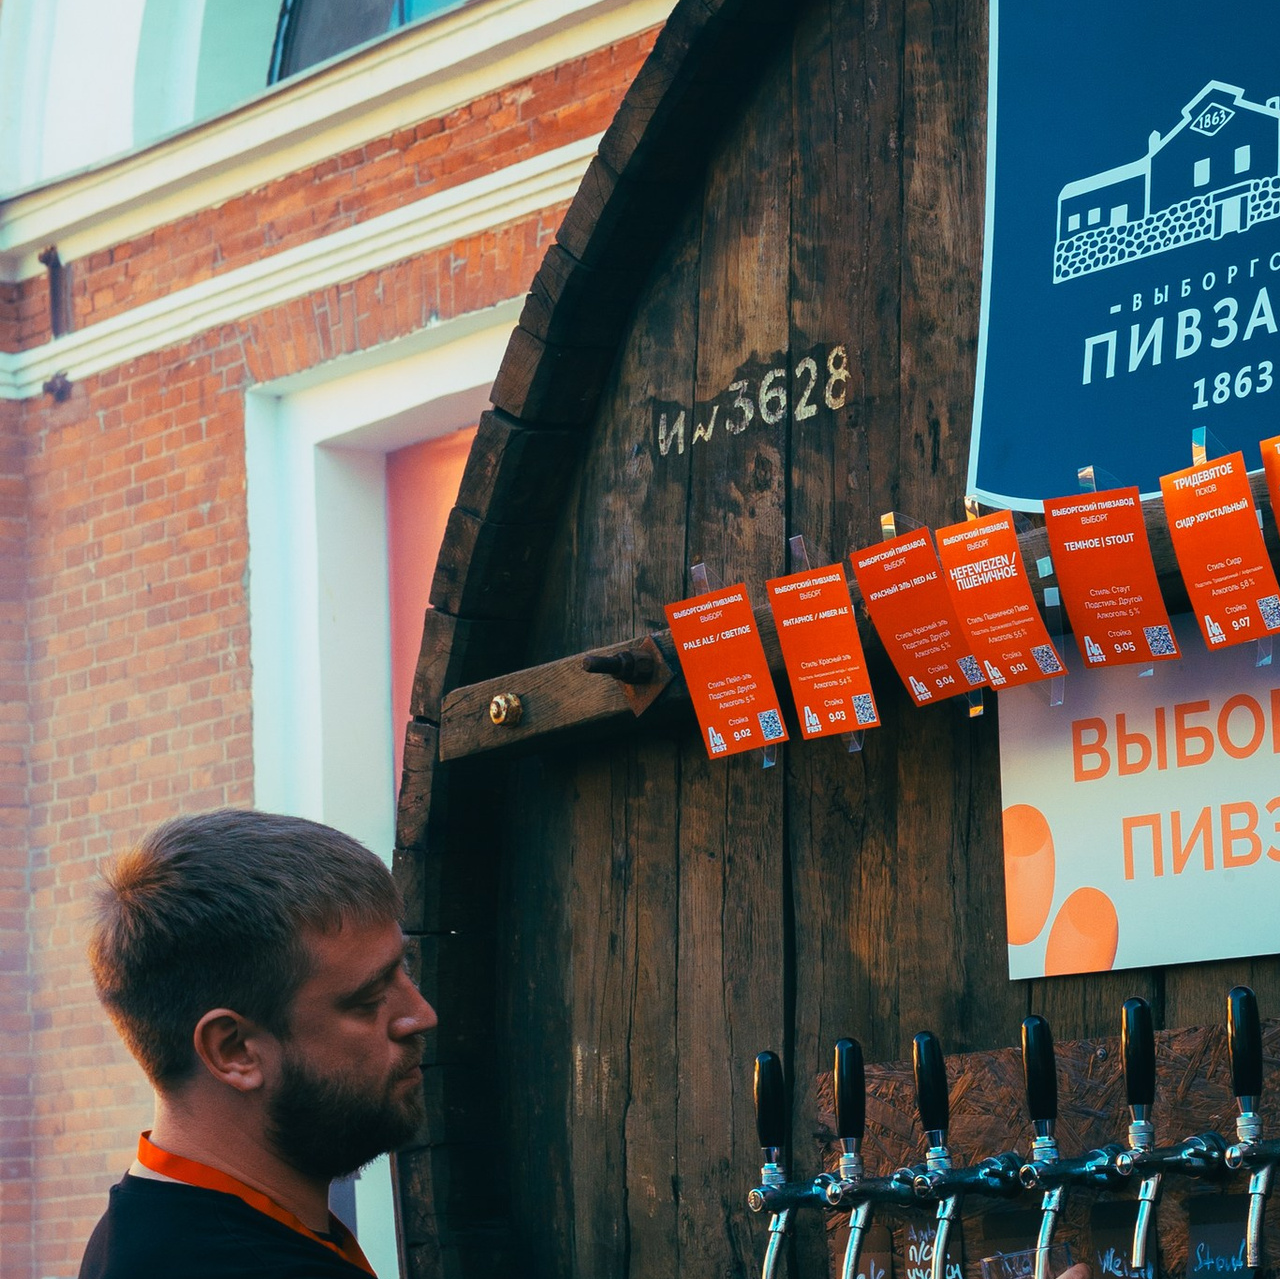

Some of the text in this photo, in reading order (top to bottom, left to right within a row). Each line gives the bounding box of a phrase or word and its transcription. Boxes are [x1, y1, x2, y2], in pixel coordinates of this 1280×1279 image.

[1199, 109, 1227, 129] 1863
[1191, 360, 1274, 411] 1863
[1173, 462, 1234, 490] ТРИДЕВЯТОЕ
[1195, 483, 1217, 497] ПСКОВ
[1051, 497, 1135, 517] ВЫБОРГСКИЙ ПИВЗАВОД
[1175, 497, 1249, 529] СИДР ХРУСТАЛЬНЫЙ
[1081, 513, 1109, 525] ВЫБОРГ
[942, 520, 1010, 546] ВЫБОРГСКИЙ ПИВЗАВОД
[966, 538, 989, 552] ВЫБОРГ
[1063, 538, 1100, 552] ТЕМНОЕ
[1105, 532, 1135, 546] STOUT
[858, 538, 927, 569] ВЫБОРГСКИЙ ПИВЗАВОД
[883, 557, 906, 572] ВЫБОРГ
[949, 553, 1010, 581] HEFEWEIZEN
[1226, 556, 1242, 566] Сидр
[774, 573, 842, 595] ВЫБОРГСКИЙ ПИВЗАВОД
[956, 564, 1018, 591] ПШЕНИЧНОЕ
[869, 584, 898, 601] КРАСНЫЙ
[898, 581, 911, 591] ЭЛЬ
[913, 575, 926, 585] RED
[925, 571, 938, 581] ALE
[1111, 585, 1131, 594] Стаут
[799, 589, 821, 601] ВЫБОРГ
[1118, 595, 1143, 606] Другой
[673, 593, 743, 619] ВЫБОРГСКИЙ ПИВЗАВОД
[1014, 604, 1029, 613] Пиво
[1225, 603, 1247, 614] Стойка
[699, 610, 723, 623] ВЫБОРГ
[782, 614, 814, 627] ЯНТАРНОЕ
[818, 609, 838, 619] AMBER
[838, 606, 849, 615] ALE
[1231, 616, 1250, 630] 9.07
[683, 638, 702, 651] PALE
[702, 635, 715, 646] ALE
[721, 624, 751, 640] СВЕТЛОЕ
[930, 630, 951, 642] Другой
[1108, 629, 1132, 638] Стойка
[1114, 641, 1136, 653] 9.05
[1002, 651, 1022, 661] Стойка
[1088, 654, 1107, 663] FEST
[927, 663, 949, 674] Стойка
[1010, 663, 1028, 675] 9.01
[737, 682, 757, 694] Другой
[935, 675, 955, 688] 9.04
[824, 698, 844, 707] Стойка
[728, 716, 749, 726] Стойка
[828, 710, 846, 723] 9.03
[733, 728, 752, 741] 9.02
